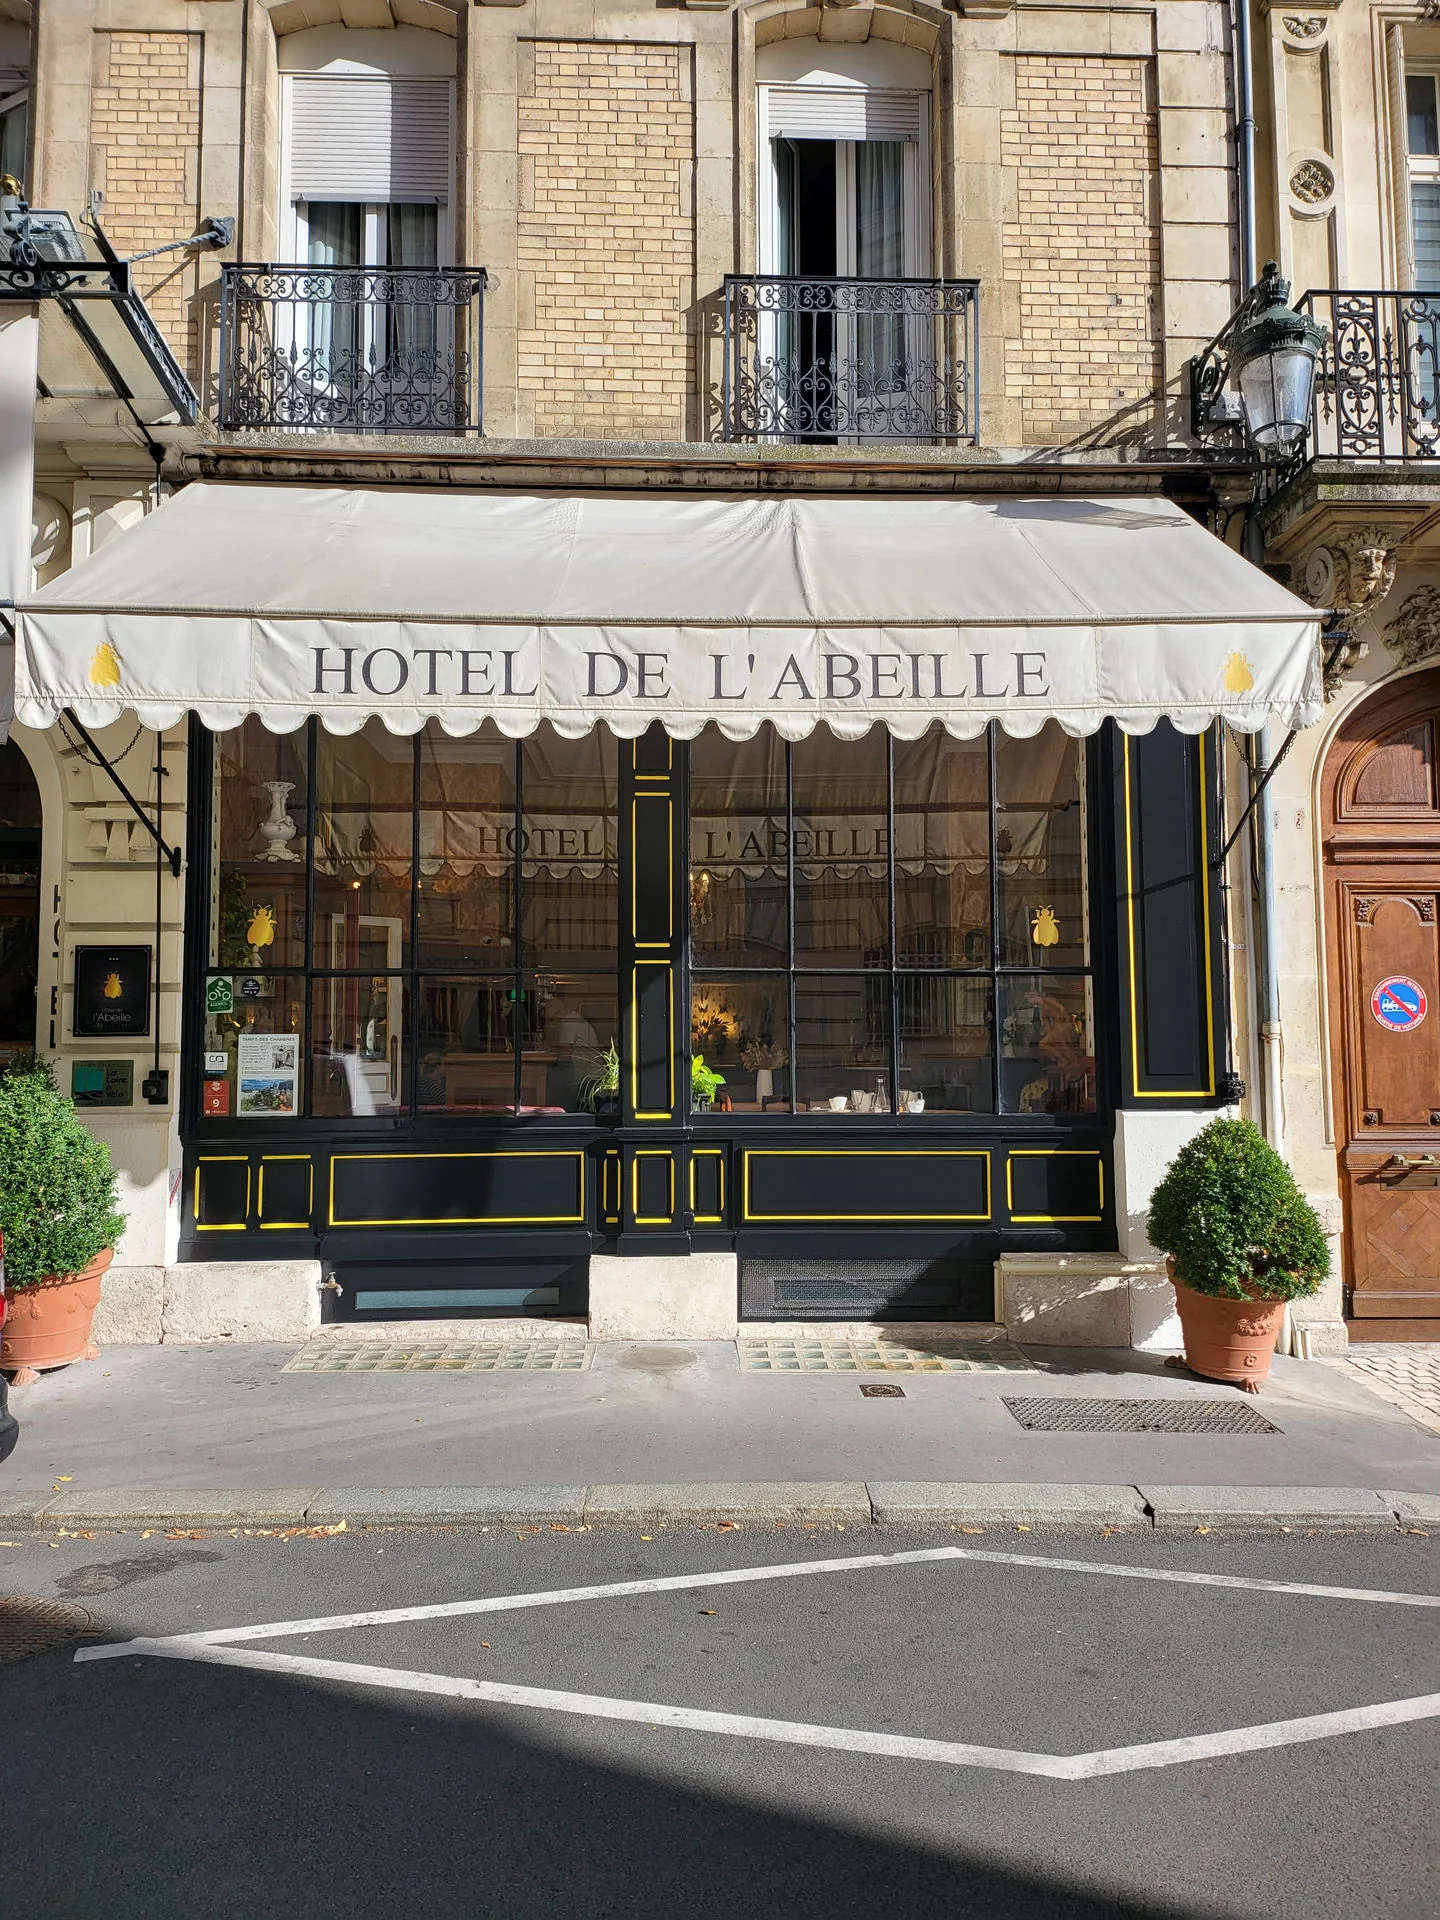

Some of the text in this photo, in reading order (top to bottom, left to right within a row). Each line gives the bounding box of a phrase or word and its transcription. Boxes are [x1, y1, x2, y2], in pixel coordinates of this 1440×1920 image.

[309, 646, 1051, 700] HOTEL DE L'ABEILLE
[93, 1012, 132, 1023] l'Abeille
[212, 1098, 220, 1108] 9
